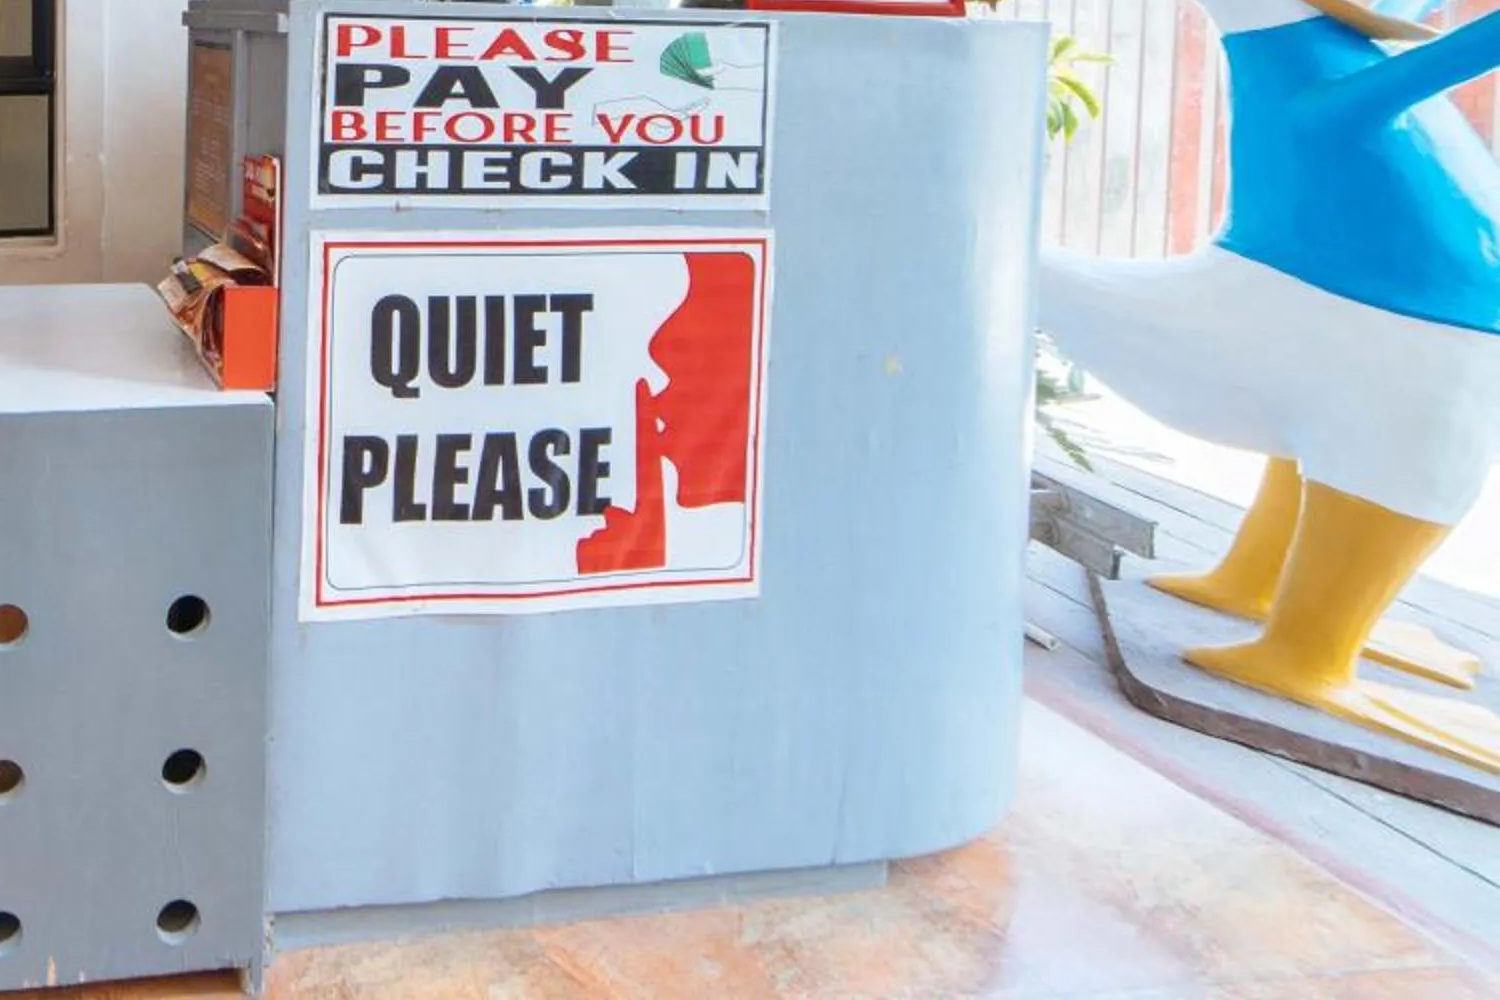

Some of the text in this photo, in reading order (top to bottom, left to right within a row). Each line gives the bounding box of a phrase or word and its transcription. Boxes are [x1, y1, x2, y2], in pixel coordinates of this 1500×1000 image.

[335, 23, 635, 62] PLEASE
[333, 63, 595, 110] PAY
[330, 110, 725, 145] BEFORE YOU
[327, 148, 640, 191] CHECK
[672, 150, 759, 191] IN
[370, 293, 595, 399] QUIET
[339, 427, 613, 525] PLEASE
